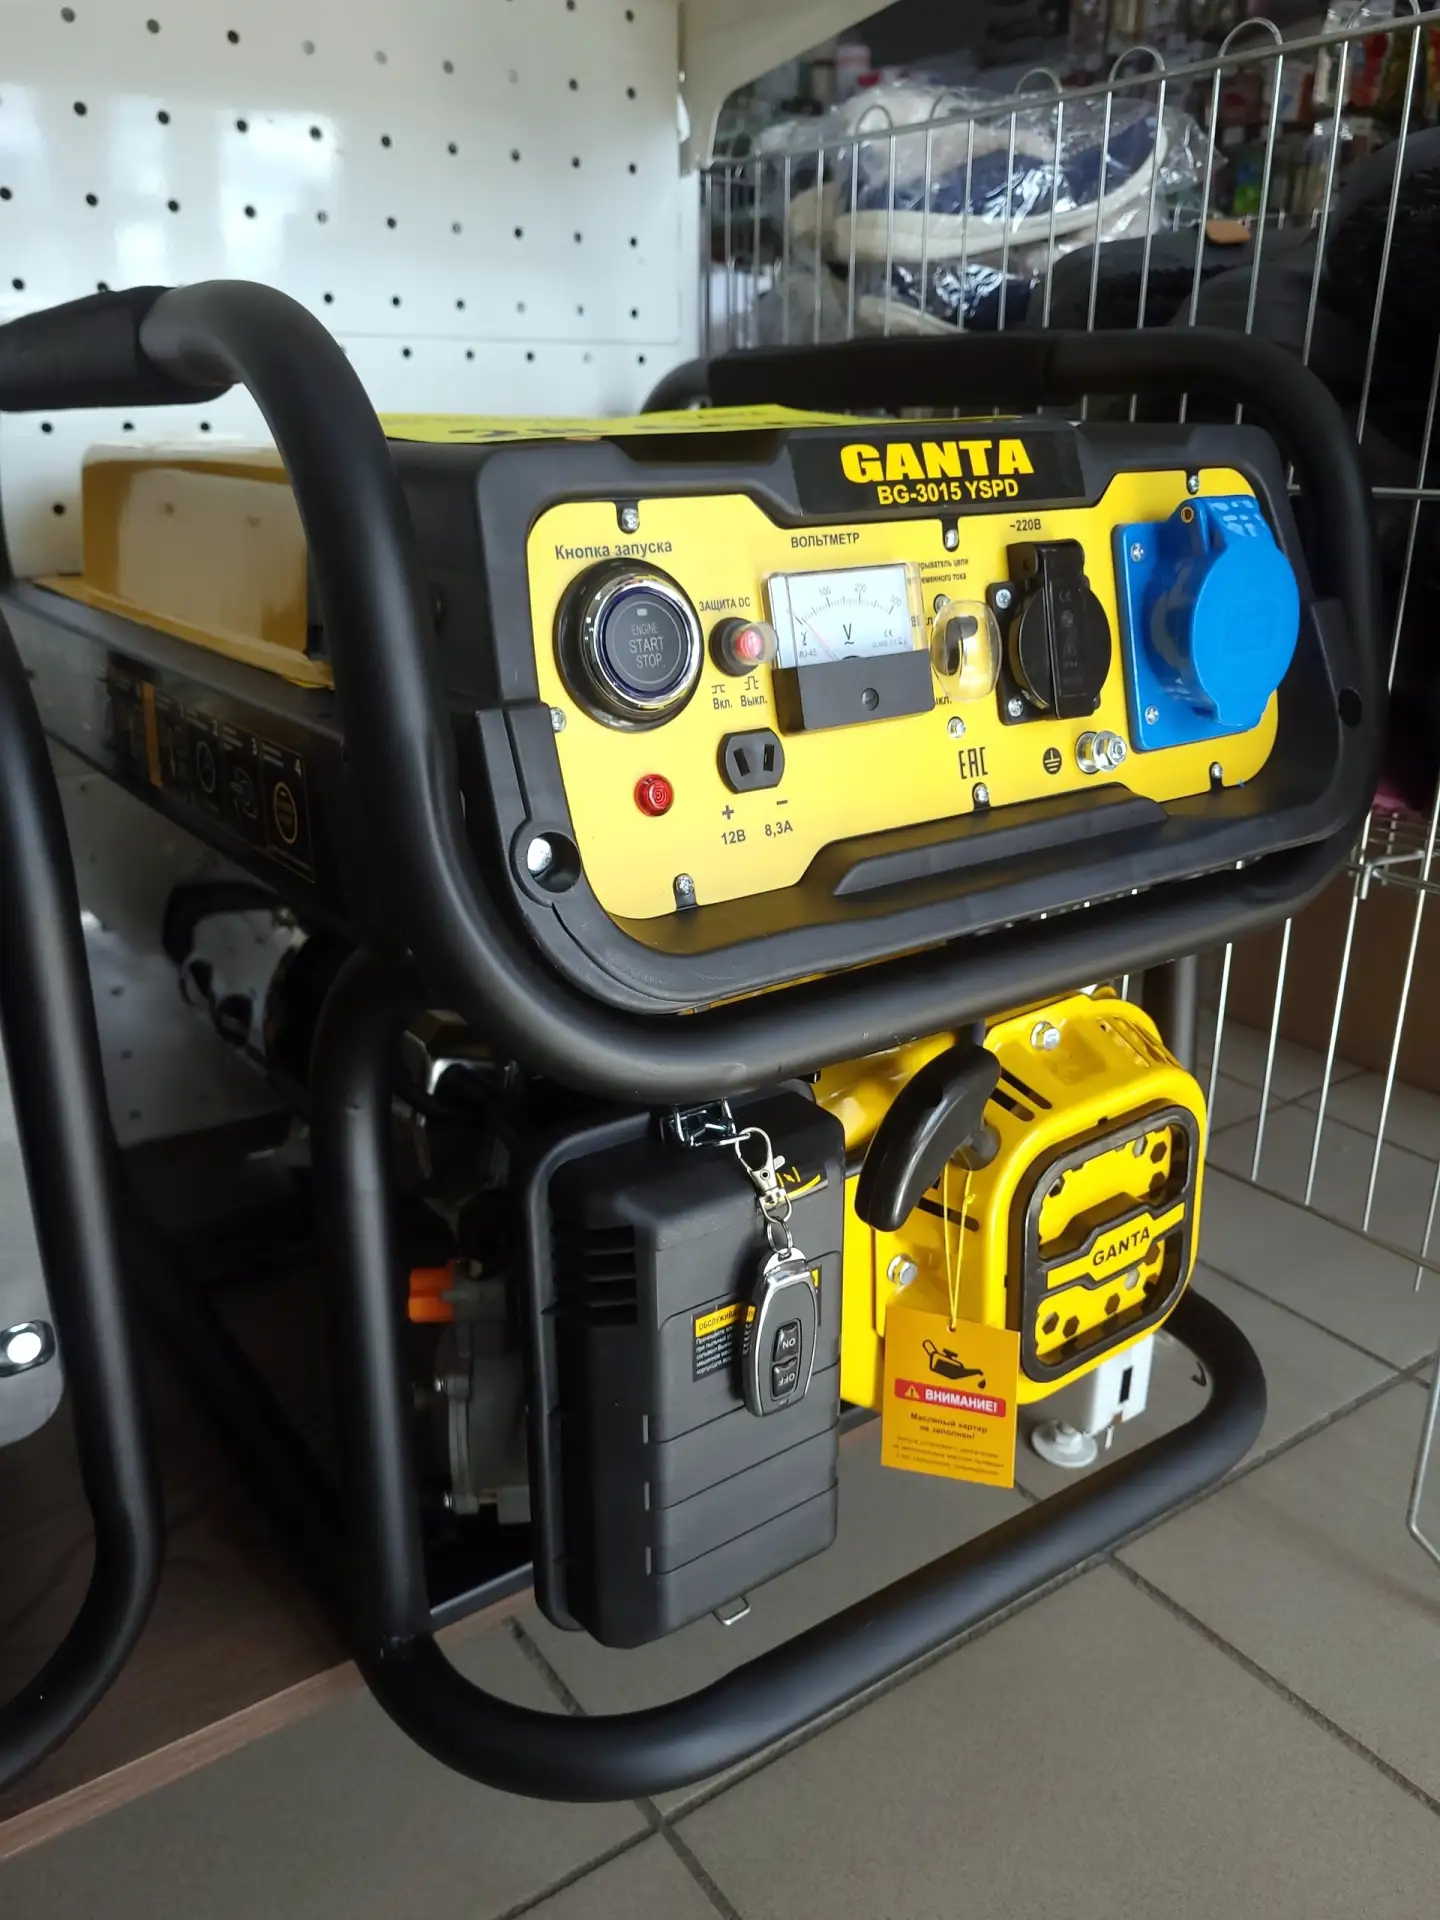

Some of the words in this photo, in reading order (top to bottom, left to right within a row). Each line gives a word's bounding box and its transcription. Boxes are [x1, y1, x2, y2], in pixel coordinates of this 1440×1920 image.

[840, 438, 1034, 484] GANTA
[877, 484, 962, 505] BG-3015
[963, 478, 1018, 500] YSPD
[790, 532, 860, 549] ВОЛЬТМЕТР
[554, 544, 611, 560] Кнопка
[614, 540, 673, 559] запуска
[919, 559, 952, 571] рыватель
[953, 557, 969, 568] цепи
[953, 571, 967, 581] тока
[818, 585, 832, 597] 100
[854, 582, 867, 594] 200
[698, 597, 737, 612] ЗАЩИТА
[738, 596, 751, 608] DC
[631, 621, 659, 636] ENGINE
[629, 636, 664, 654] START
[636, 652, 663, 669] STOP
[712, 697, 733, 710] Вкл.
[740, 694, 768, 707] Выкл.
[721, 828, 746, 846] 12В
[764, 820, 793, 838] 8,3А
[1092, 1226, 1150, 1267] GANTA
[698, 1310, 737, 1331] ОБСЛУЖИВА
[782, 1337, 796, 1350] ON
[778, 1372, 796, 1387] OFF
[925, 1387, 998, 1413] ВНИМАНИЕ!
[910, 1411, 956, 1427] Масляный
[958, 1421, 988, 1434] картер
[919, 1424, 930, 1432] не
[932, 1427, 975, 1441] заполнен!
